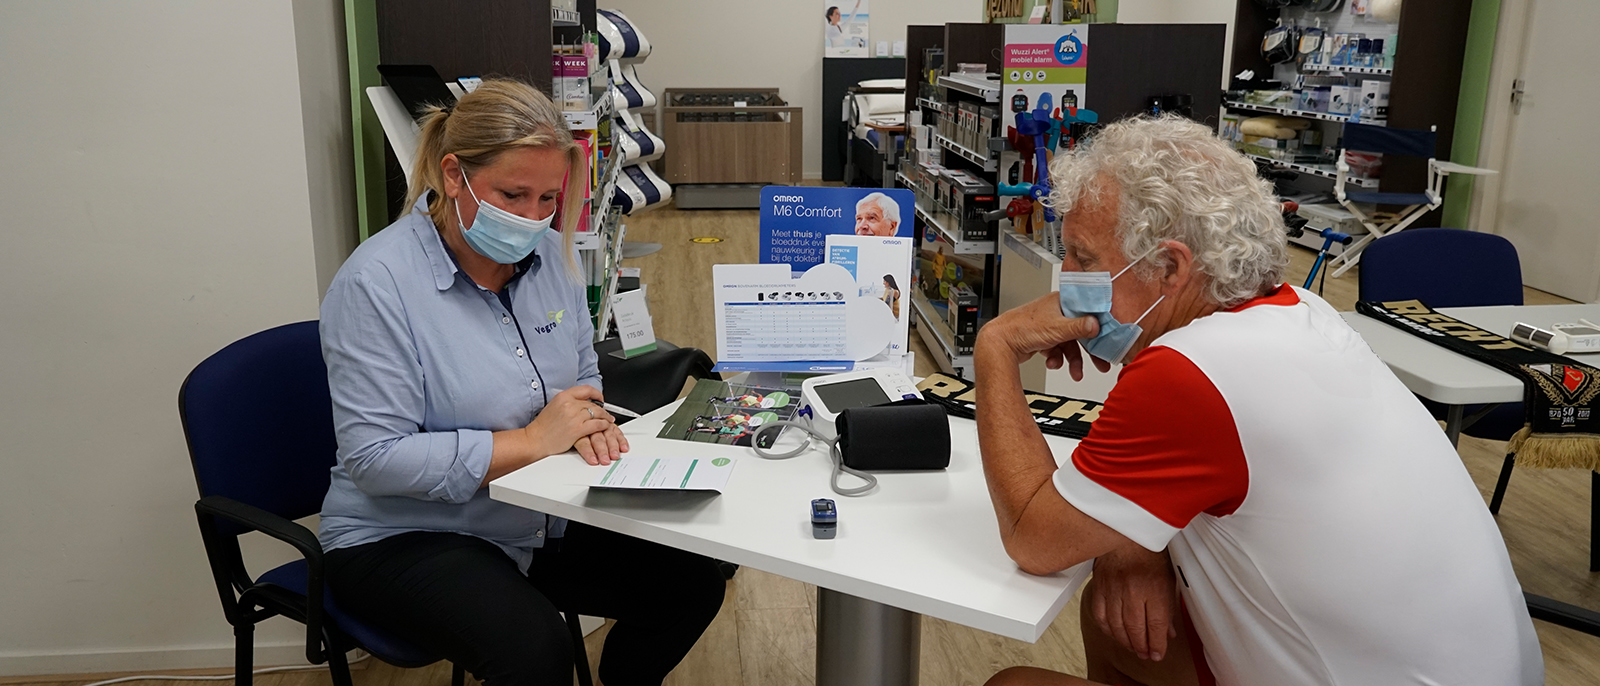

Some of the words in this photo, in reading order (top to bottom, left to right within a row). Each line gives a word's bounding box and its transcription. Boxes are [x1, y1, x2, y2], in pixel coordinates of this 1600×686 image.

[773, 195, 804, 203] OMRON
[773, 205, 793, 216] M6
[795, 205, 842, 218] Comfort
[771, 229, 791, 237] Meet
[793, 230, 813, 238] thuis
[814, 231, 822, 239] je
[771, 238, 810, 246] bloeddruk
[771, 247, 815, 256] nauwkeurig
[771, 254, 780, 263] bij
[793, 255, 820, 263] dokter!
[534, 321, 557, 335] Vegro
[1381, 299, 1535, 352] RECHT
[1562, 406, 1575, 416] 50
